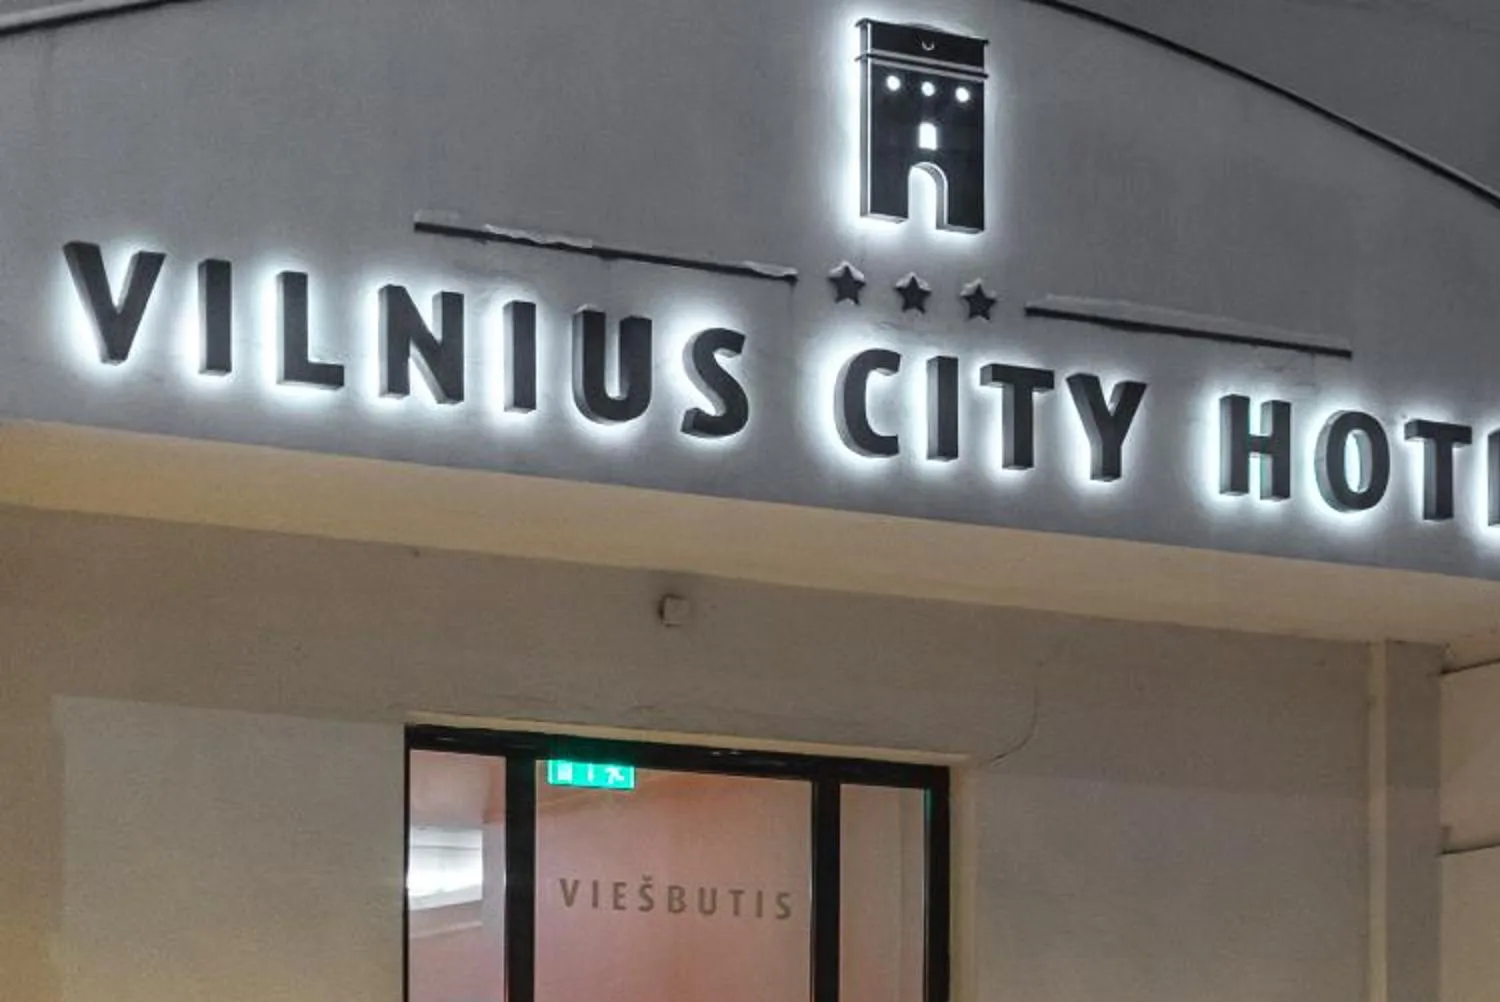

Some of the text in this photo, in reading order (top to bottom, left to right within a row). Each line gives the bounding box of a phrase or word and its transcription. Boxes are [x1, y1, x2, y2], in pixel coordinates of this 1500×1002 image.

[62, 240, 751, 439] VILNIUS
[835, 348, 1148, 482] CITY
[559, 875, 794, 920] VIEŠBUTIS
